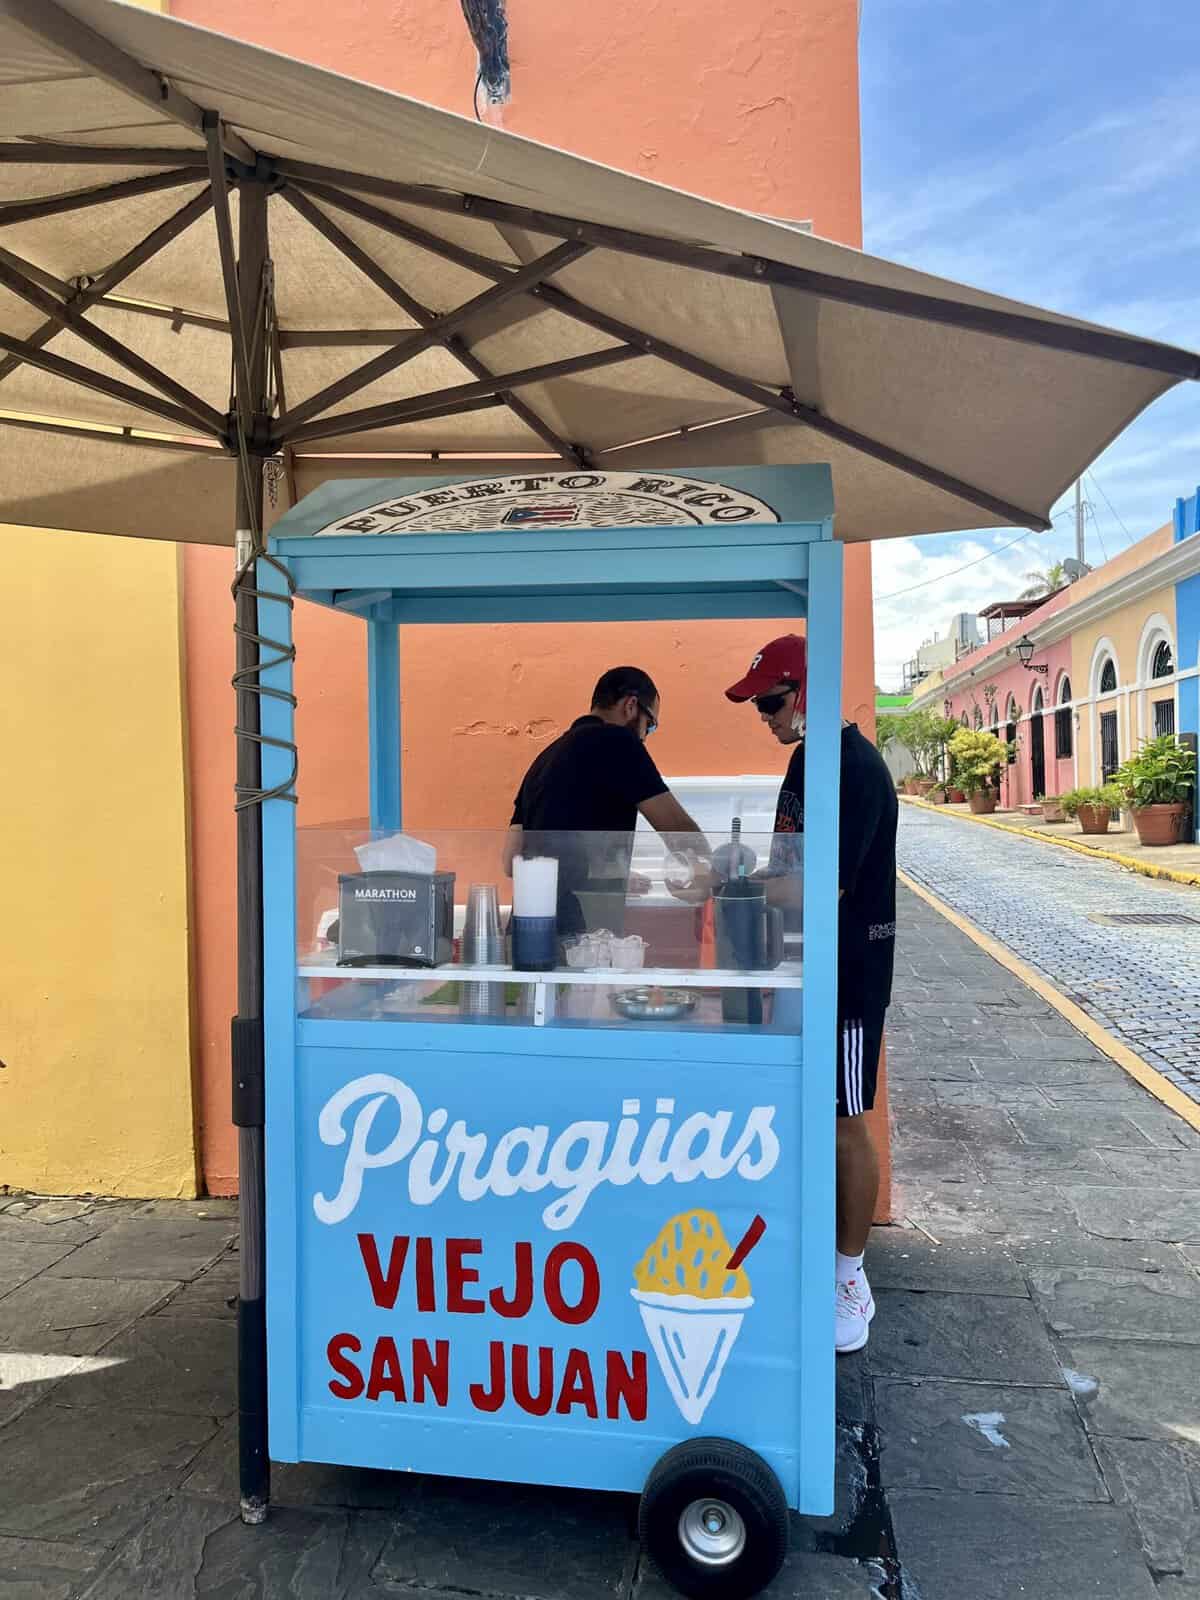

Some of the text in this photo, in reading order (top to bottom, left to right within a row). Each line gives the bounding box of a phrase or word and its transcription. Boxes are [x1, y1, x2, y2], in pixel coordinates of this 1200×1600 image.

[336, 475, 760, 533] PUERTO RICO
[355, 889, 416, 899] MARATHON
[313, 1073, 780, 1230] Piragüas
[357, 1234, 600, 1324] VIEJO
[326, 1333, 648, 1421] SAN JUAN
